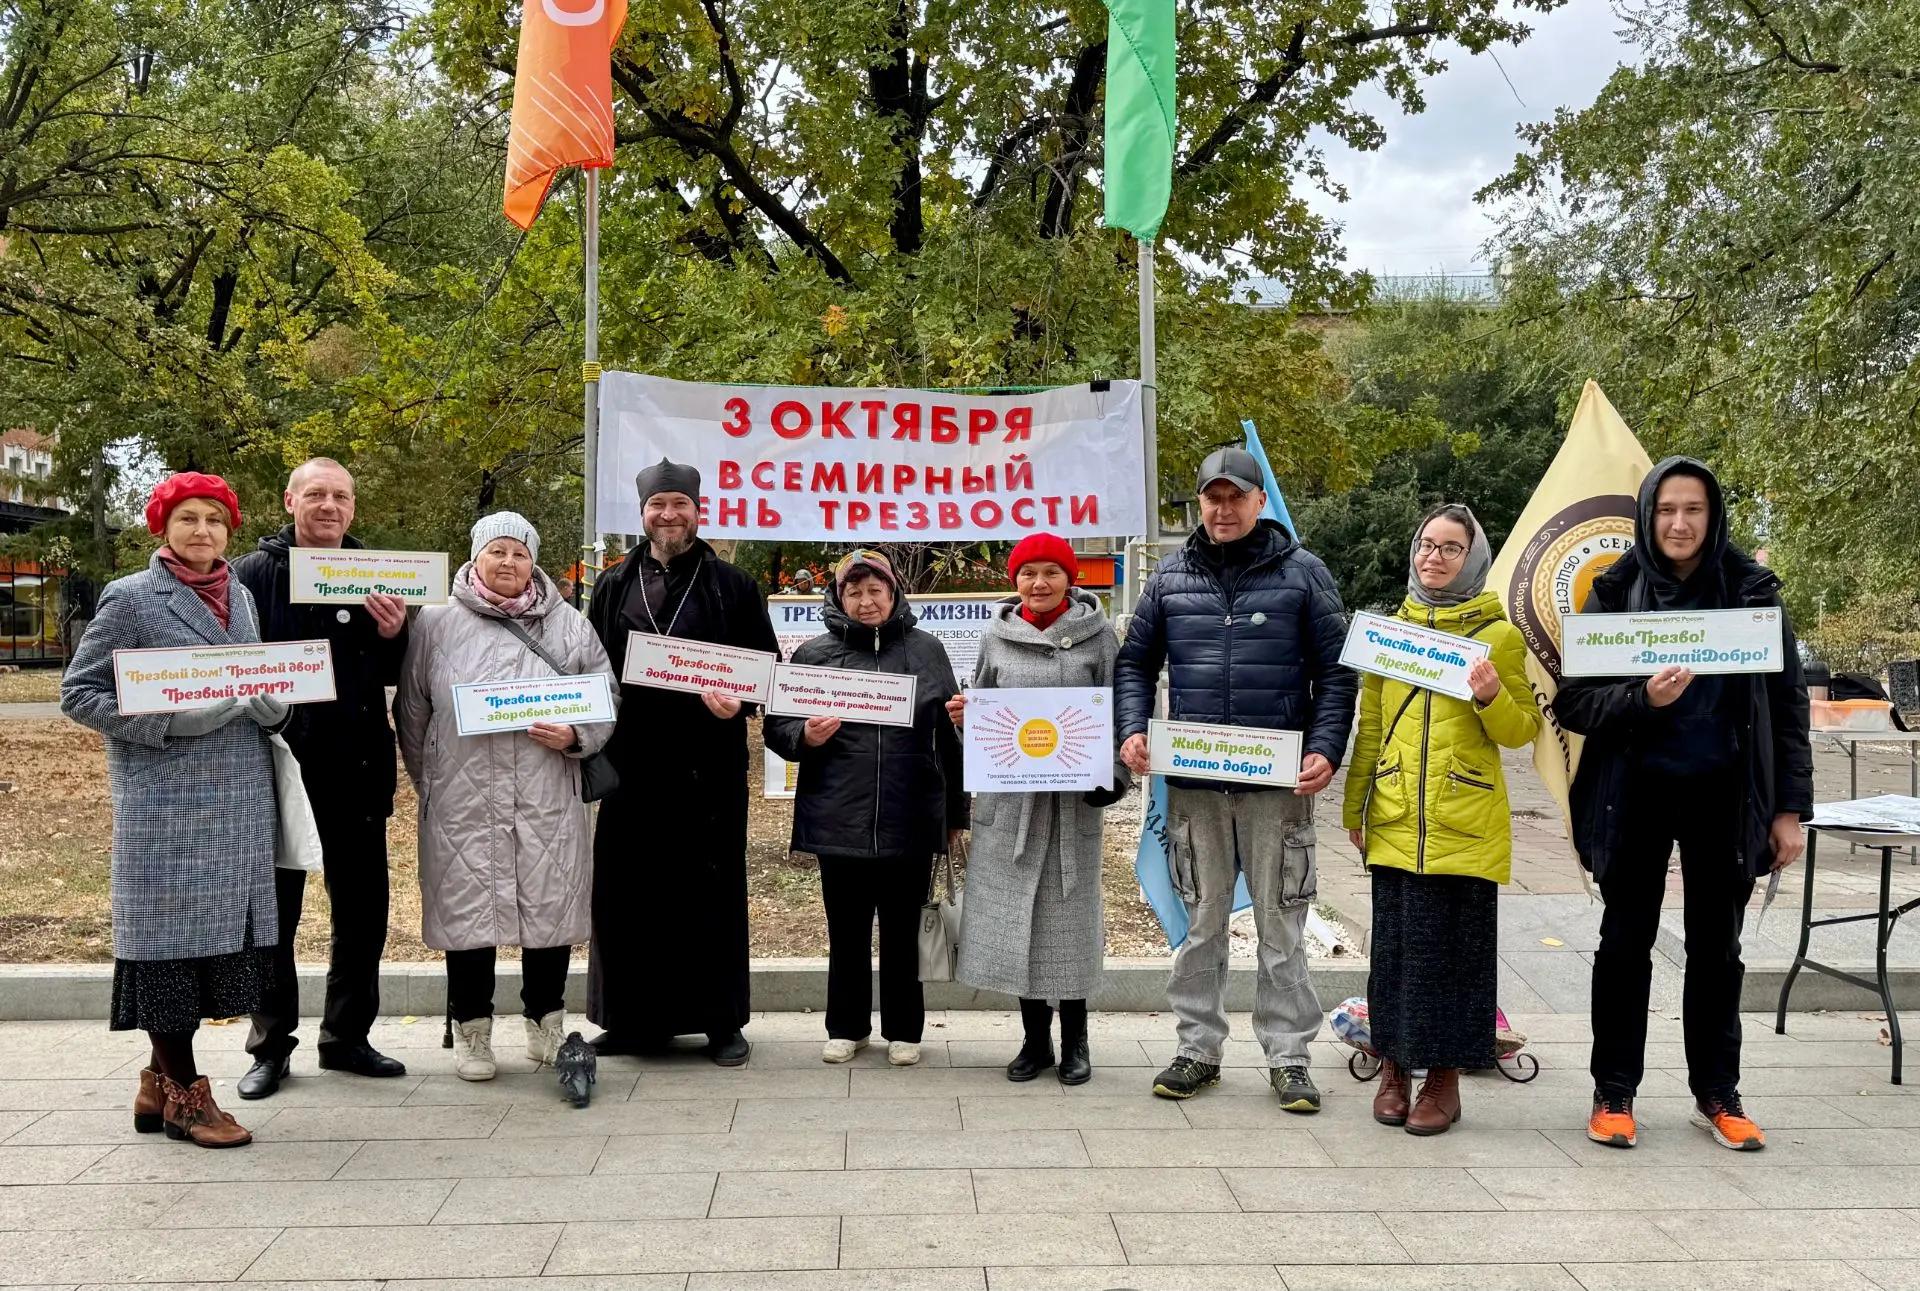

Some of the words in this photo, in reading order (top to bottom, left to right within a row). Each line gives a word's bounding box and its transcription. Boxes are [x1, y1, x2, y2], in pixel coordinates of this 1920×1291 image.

[722, 397, 752, 438] 3
[770, 400, 1033, 445] ОКТЯБРЯ
[718, 454, 1034, 496] ВСЕМИРНЫЙ
[698, 496, 782, 528] ЕНЬ
[818, 494, 1098, 531] ТРЕЗВОСТИ
[1600, 538, 1632, 551] СЕР
[318, 566, 374, 580] Трезвая
[378, 568, 416, 579] семья
[314, 583, 370, 596] Трезвая
[374, 584, 427, 596] Россия!
[1556, 556, 1580, 614] ОБЩЕСТВ
[782, 606, 826, 622] ТРЕЗ
[919, 604, 992, 620] ЖИЗНЬ
[1514, 582, 1540, 650] Возродилось
[1366, 630, 1426, 656] Счастье
[1427, 648, 1467, 667] быть
[1576, 630, 1705, 647] #ЖивиТрезво!
[668, 654, 733, 674] Трезвость
[1374, 652, 1444, 680] трезвым!
[1630, 647, 1768, 665] #ДелайДобро!
[125, 669, 188, 684] Трезвый
[191, 667, 223, 680] дом!
[225, 663, 286, 678] Трезвый
[289, 660, 325, 674] двор!
[646, 668, 688, 683] добрая
[691, 674, 756, 693] традиция!
[162, 685, 234, 703] Трезвый
[238, 681, 294, 697] МИР!
[485, 694, 542, 708] Трезвая
[544, 692, 582, 702] семья
[779, 683, 825, 695] Трезвость
[831, 689, 875, 700] ценность,
[876, 693, 907, 702] данная
[487, 707, 551, 722] здоровые
[554, 703, 592, 714] дети!
[793, 697, 832, 707] человеку
[833, 700, 846, 708] от
[847, 702, 892, 712] рождения!
[1172, 737, 1213, 753] Живу
[1214, 740, 1275, 758] трезво,
[1173, 755, 1220, 770] делаю
[1223, 760, 1272, 776] добро!
